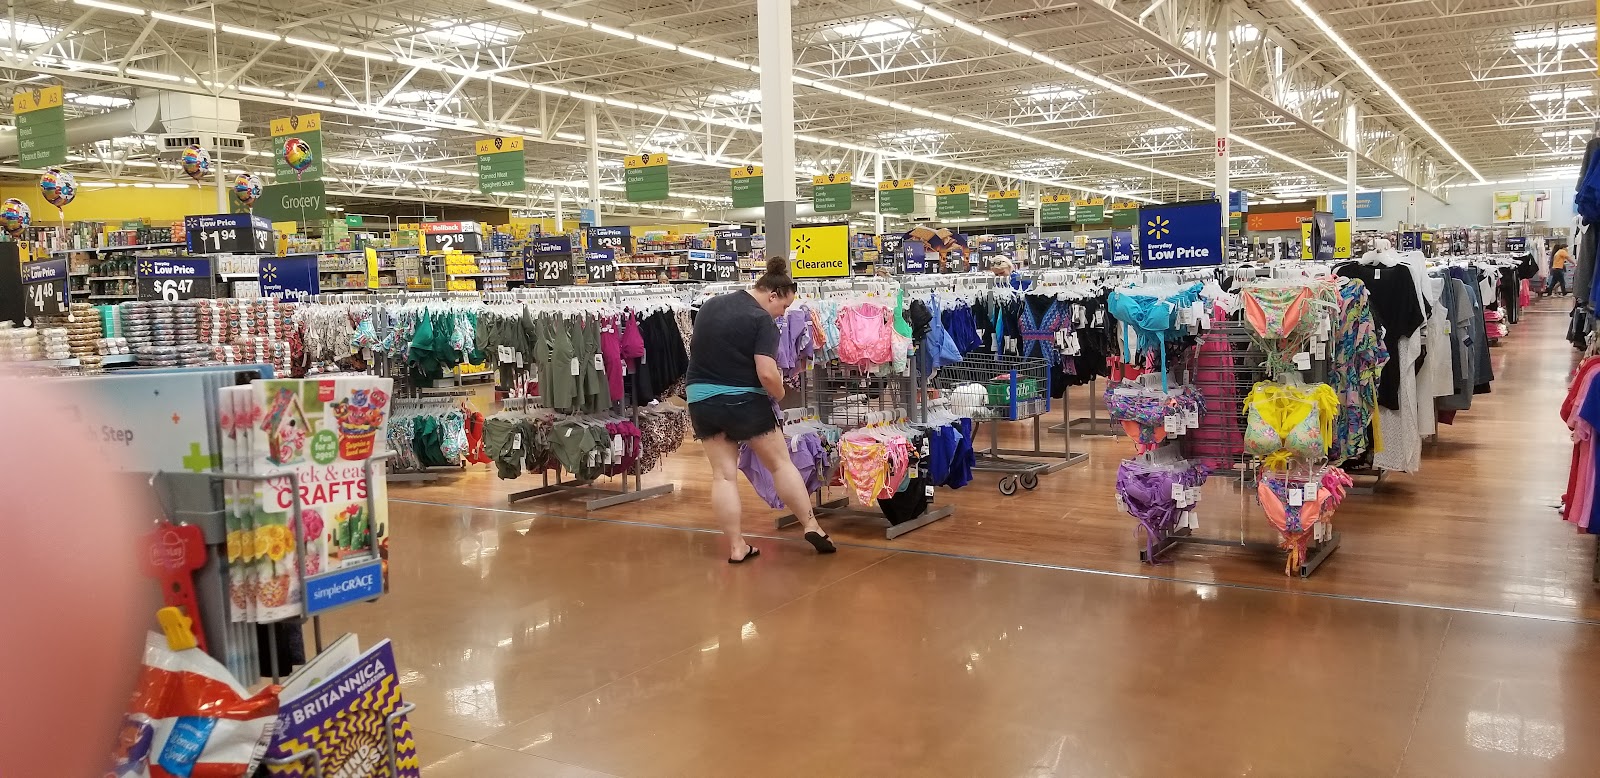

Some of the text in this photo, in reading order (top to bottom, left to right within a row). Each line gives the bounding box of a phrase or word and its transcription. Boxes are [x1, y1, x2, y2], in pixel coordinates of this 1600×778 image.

[19, 92, 58, 109] A2 A3
[19, 116, 27, 124] Tea
[20, 127, 32, 136] Bread
[274, 120, 316, 133] A4 A5
[21, 140, 35, 149] Coffee
[480, 144, 488, 152] A6
[22, 151, 50, 162] Peanut Butter
[481, 172, 496, 180] Canned
[281, 195, 320, 211] Grocery
[1148, 246, 1209, 261] Low Price
[154, 265, 195, 274] Low Price
[796, 259, 843, 269] Clearance
[31, 267, 56, 279] Low Price
[526, 271, 535, 280] Lo
[264, 288, 308, 299] Low Price
[102, 425, 134, 446] Step
[319, 434, 332, 442] Fun
[315, 441, 336, 451] for all
[315, 450, 335, 461] ages!
[267, 465, 319, 491] Quick
[325, 464, 339, 482] &
[277, 478, 368, 509] CRAFTS
[292, 658, 386, 725] BRITANNICA
